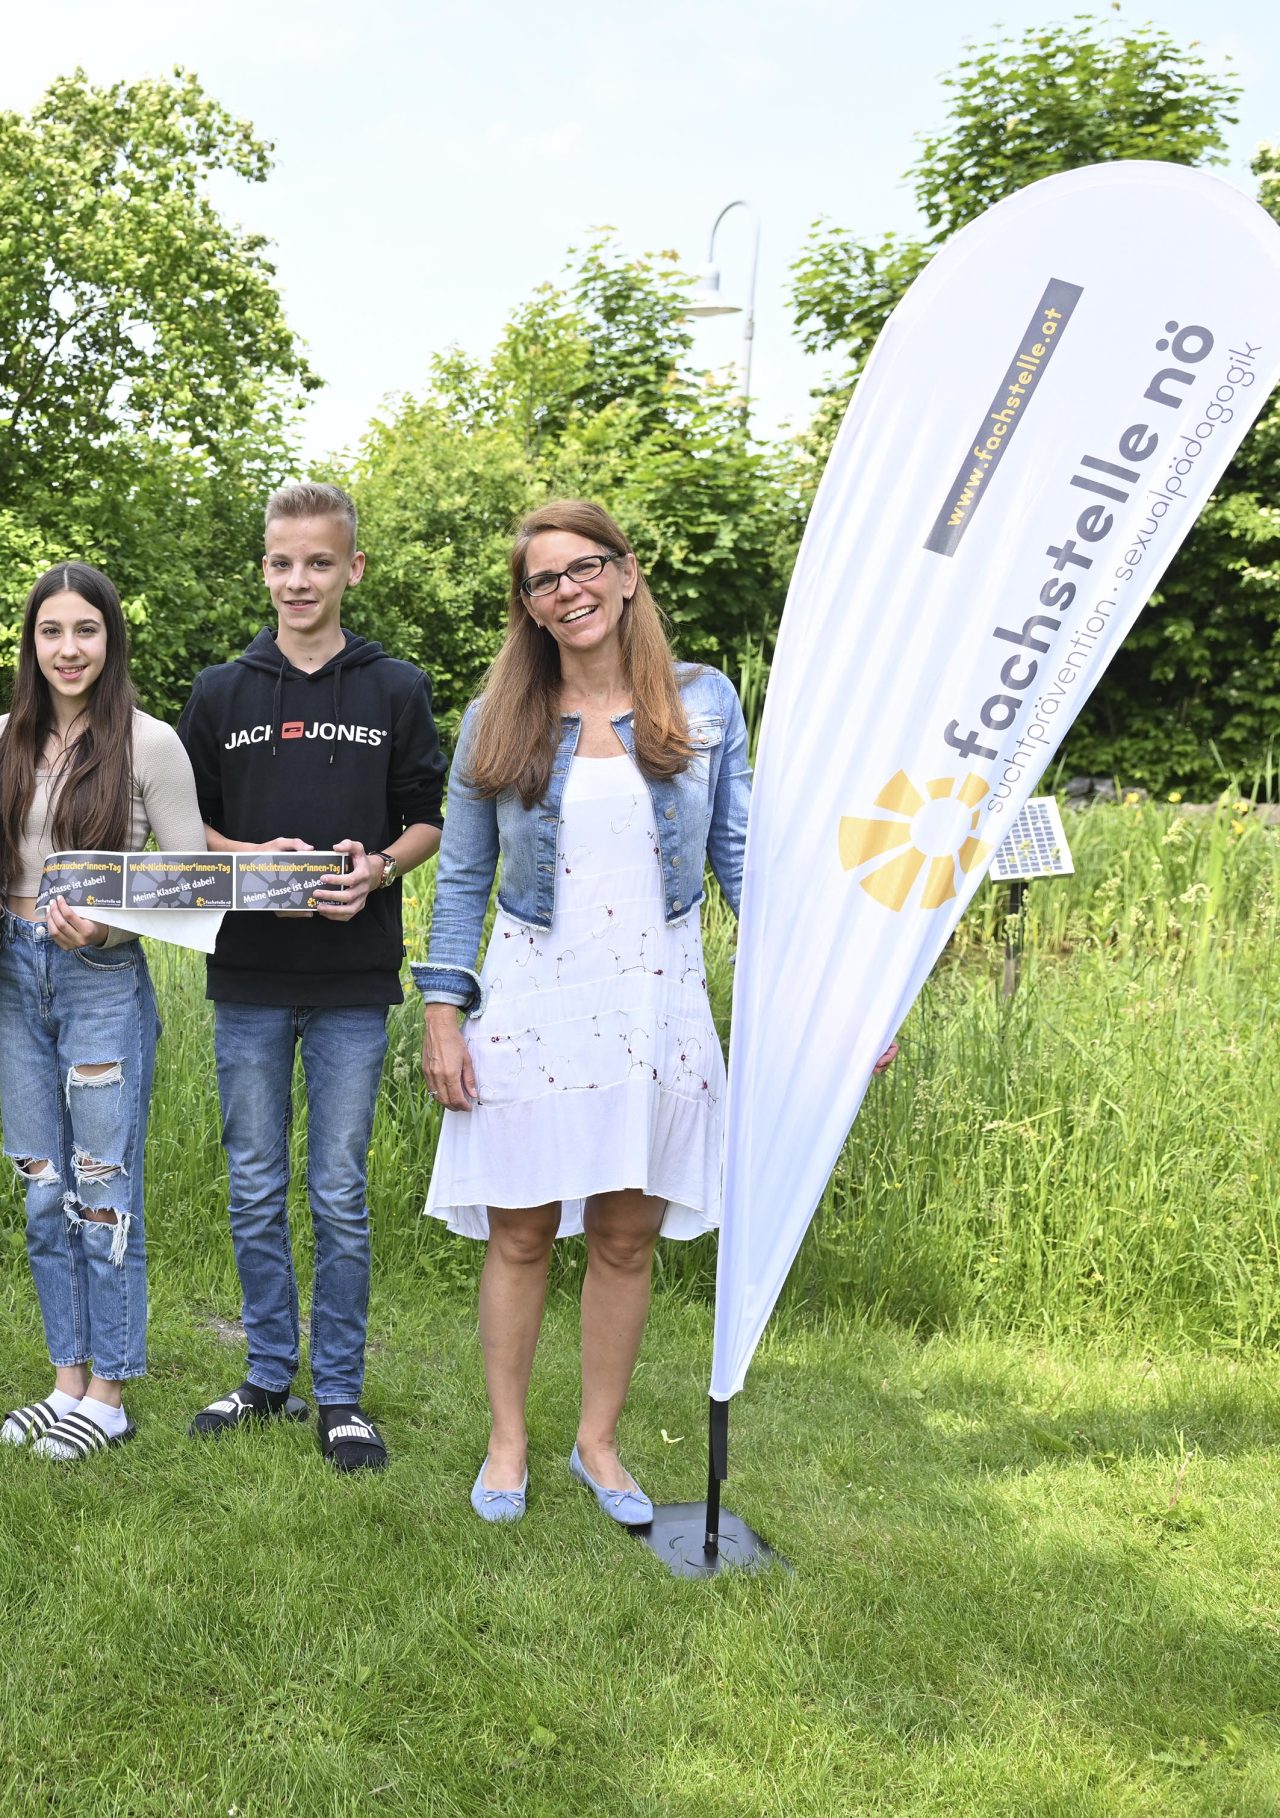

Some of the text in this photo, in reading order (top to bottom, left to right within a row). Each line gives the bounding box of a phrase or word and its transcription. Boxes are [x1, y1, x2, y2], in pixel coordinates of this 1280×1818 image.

[947, 307, 1062, 526] www.fachstelle.at
[944, 320, 1215, 761] fachstelle nö
[988, 599, 1117, 813] suchtprävention
[1115, 341, 1263, 581] sexualpädagogik
[49, 882, 71, 896] Klasse
[71, 880, 82, 889] ist
[82, 875, 106, 887] dabei!
[133, 876, 216, 903] Meine Klasse ist dabei!
[243, 878, 327, 904] Meine Klasse ist dabe
[328, 1425, 370, 1443] PUMA
